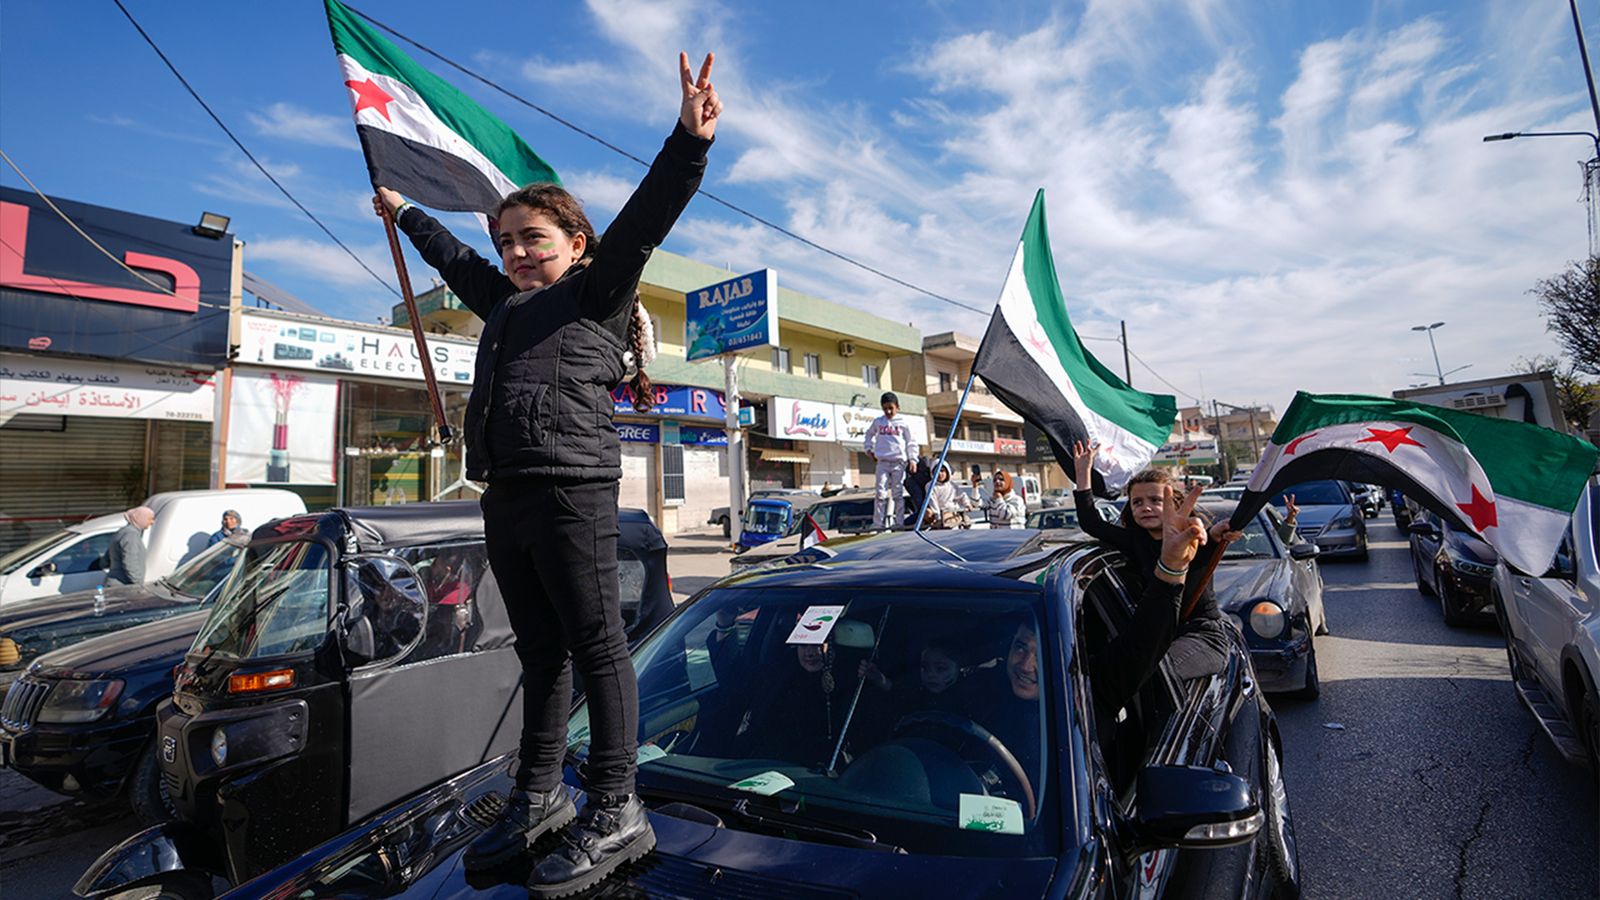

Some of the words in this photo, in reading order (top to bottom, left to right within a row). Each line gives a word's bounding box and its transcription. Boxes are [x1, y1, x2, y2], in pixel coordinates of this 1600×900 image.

[698, 278, 753, 308] RAJAB
[729, 332, 762, 346] 03/651843
[361, 337, 449, 363] HAUS
[360, 358, 448, 376] ELECTC
[25, 391, 70, 409] إيمان
[79, 391, 141, 409] الأستاذة
[692, 390, 707, 413] R
[619, 426, 651, 440] GREE
